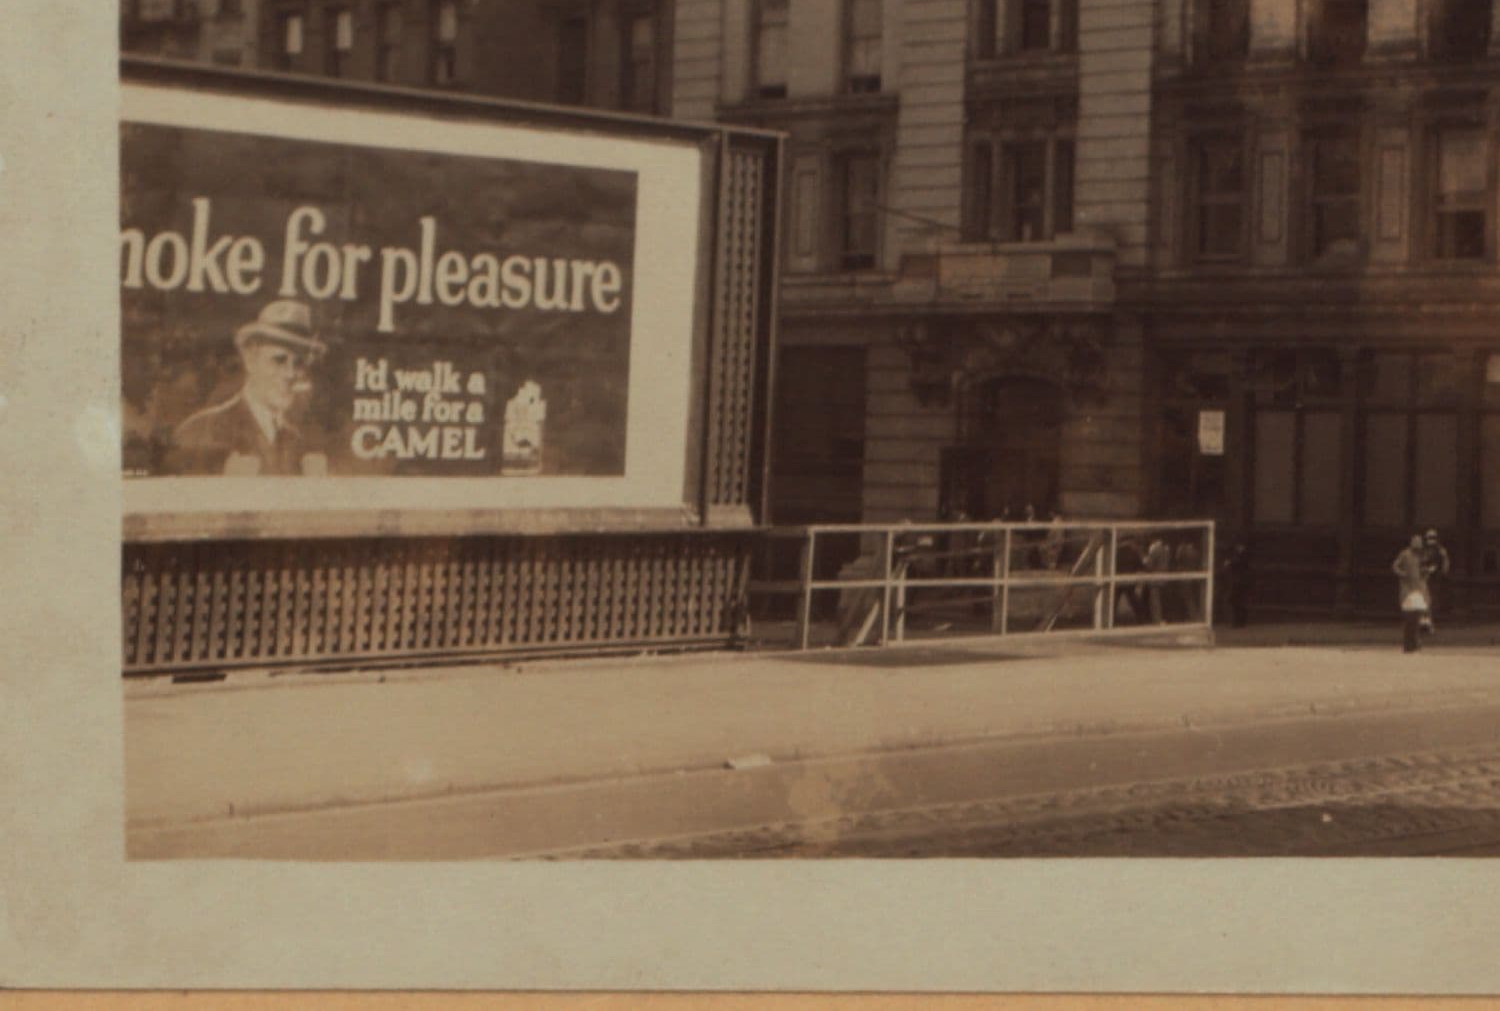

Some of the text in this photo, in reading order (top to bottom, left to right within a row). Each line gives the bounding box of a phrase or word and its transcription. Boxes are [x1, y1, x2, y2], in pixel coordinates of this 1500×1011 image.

[278, 205, 372, 300] for
[377, 215, 621, 333] pleasure
[394, 361, 460, 393] walk
[467, 372, 486, 395] a
[353, 391, 484, 423] mile for a
[351, 424, 486, 459] CAMEL
